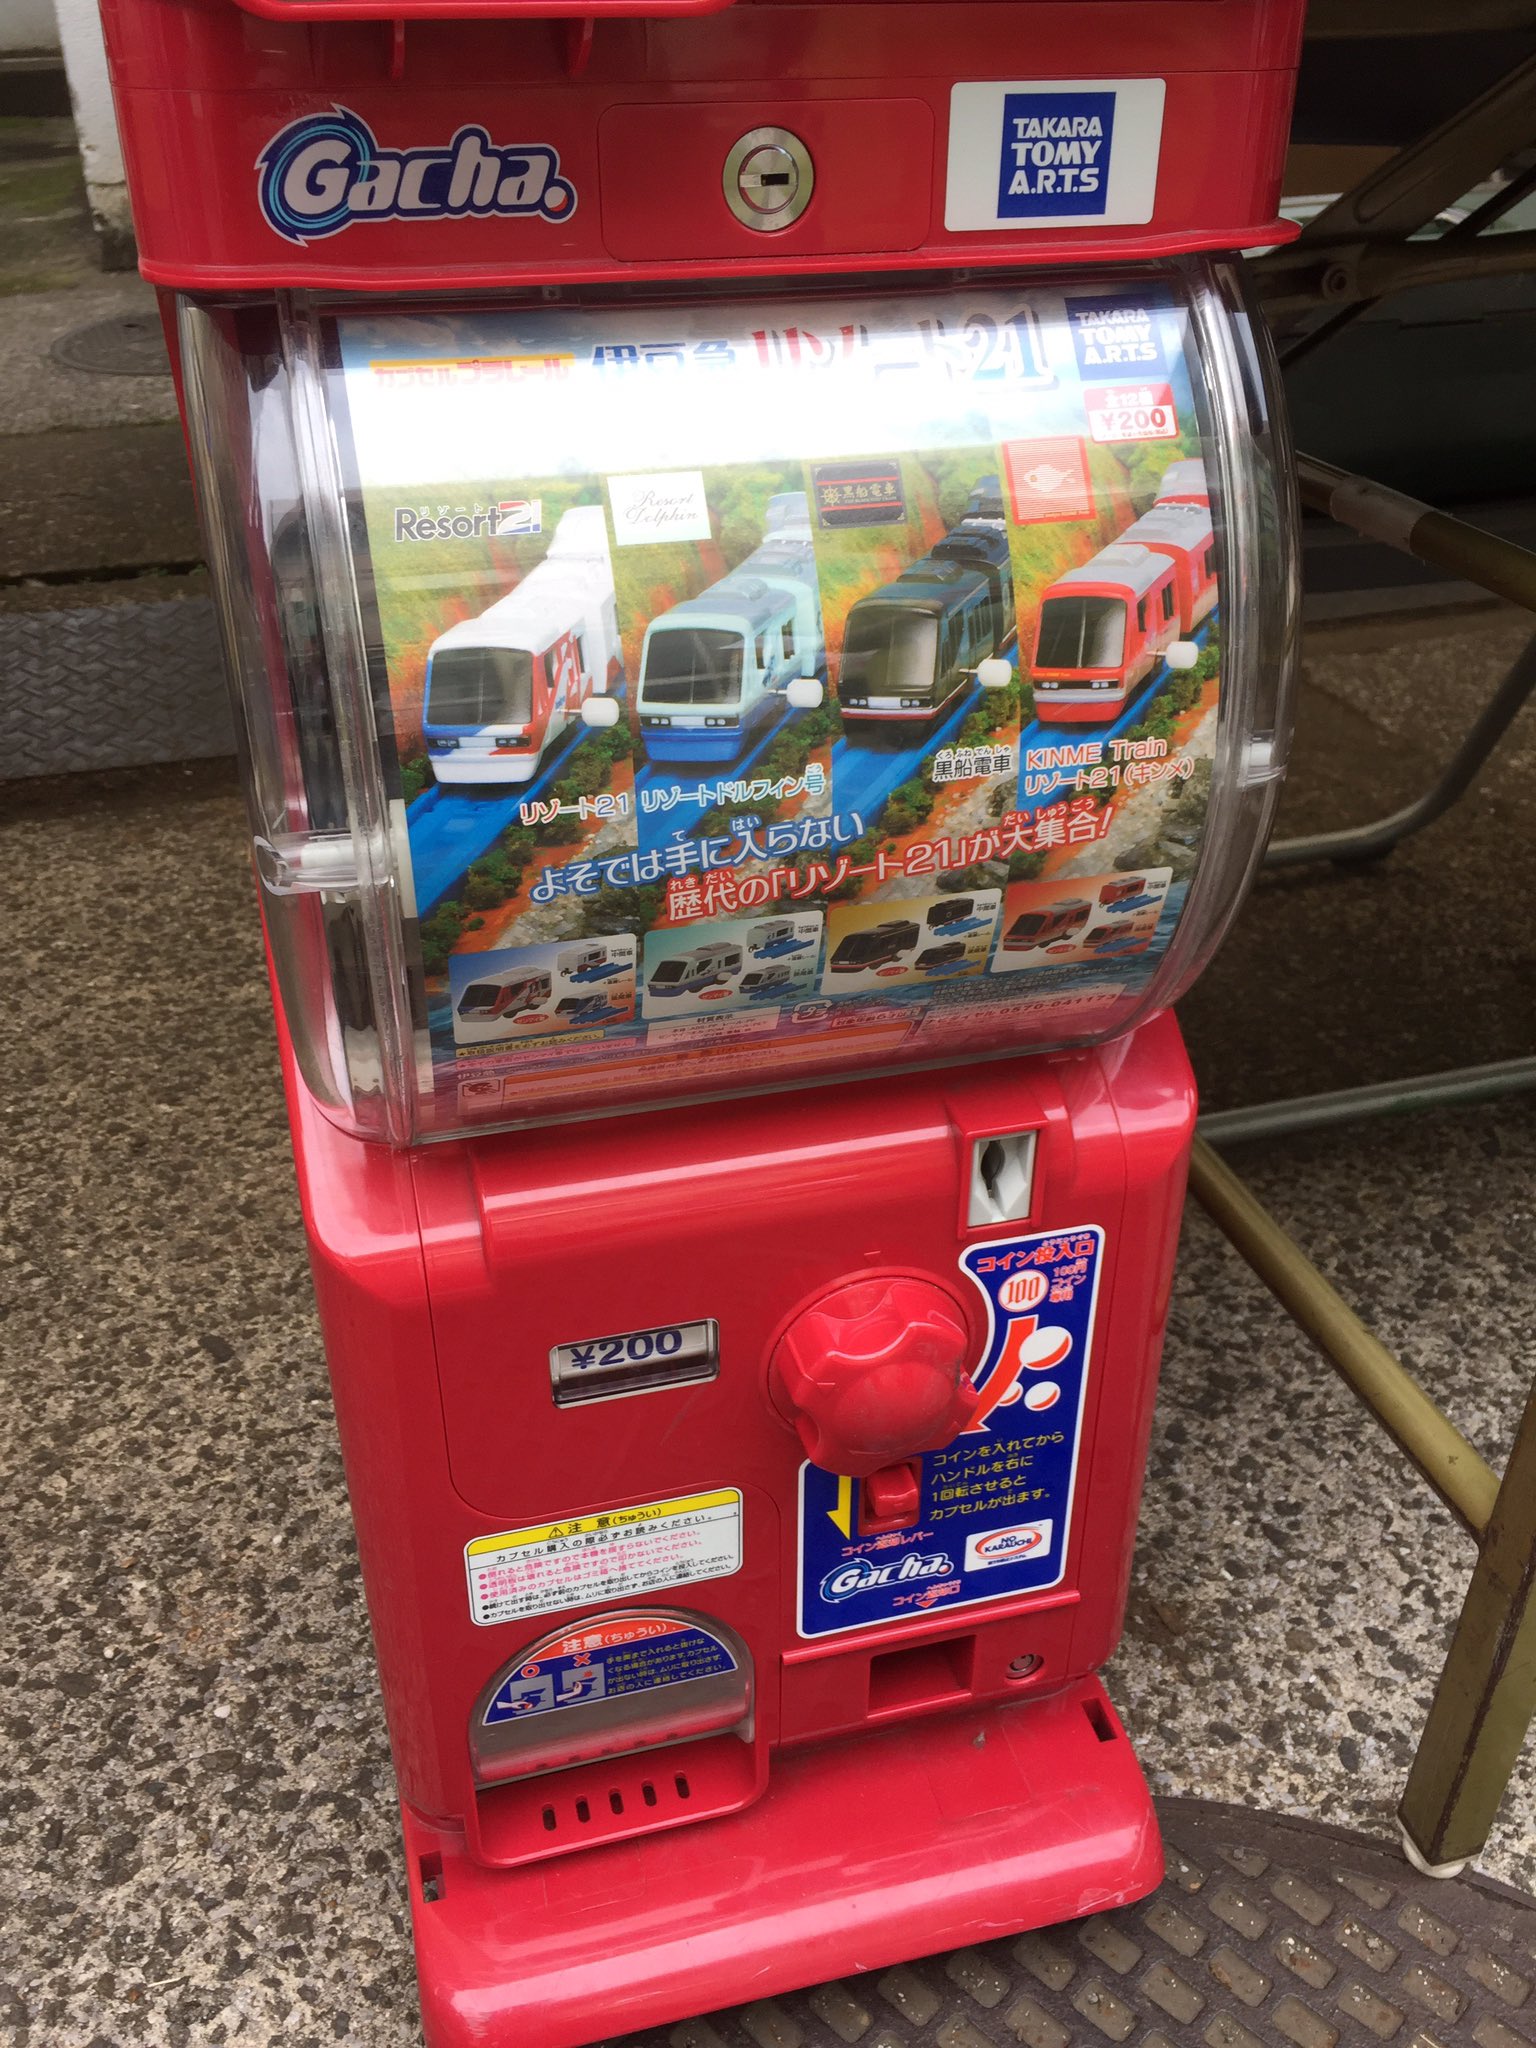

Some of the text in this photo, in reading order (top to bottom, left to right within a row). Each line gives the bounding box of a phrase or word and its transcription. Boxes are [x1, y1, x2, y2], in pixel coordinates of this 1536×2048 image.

[1012, 115, 1103, 139] TAKARA
[1010, 140, 1103, 167] TOMY
[1007, 168, 1100, 195] A.R.T.S
[1075, 308, 1151, 327] TAKARA
[1078, 324, 1152, 346] TOMY
[1083, 342, 1158, 365] A.R.T.S
[1100, 408, 1167, 431] ¥200
[1026, 736, 1168, 771] KINME Train
[933, 754, 1012, 782] 黒船電車
[641, 770, 826, 813] リゾートドルフィン号
[519, 793, 630, 826] リゾート21
[531, 812, 865, 902] よそでは手に入らない
[976, 1238, 1096, 1273] コイン投入口
[1005, 1276, 1041, 1305] 100
[570, 1330, 683, 1369] ¥200
[932, 1431, 1065, 1467] コインを入れてから
[931, 1455, 1034, 1486] ハンドルを右に
[931, 1475, 1027, 1503] 1回転させると
[929, 1488, 1051, 1521] カプセルが出ます。
[984, 1538, 1033, 1553] KARAUCHI
[1001, 1535, 1017, 1545] NO
